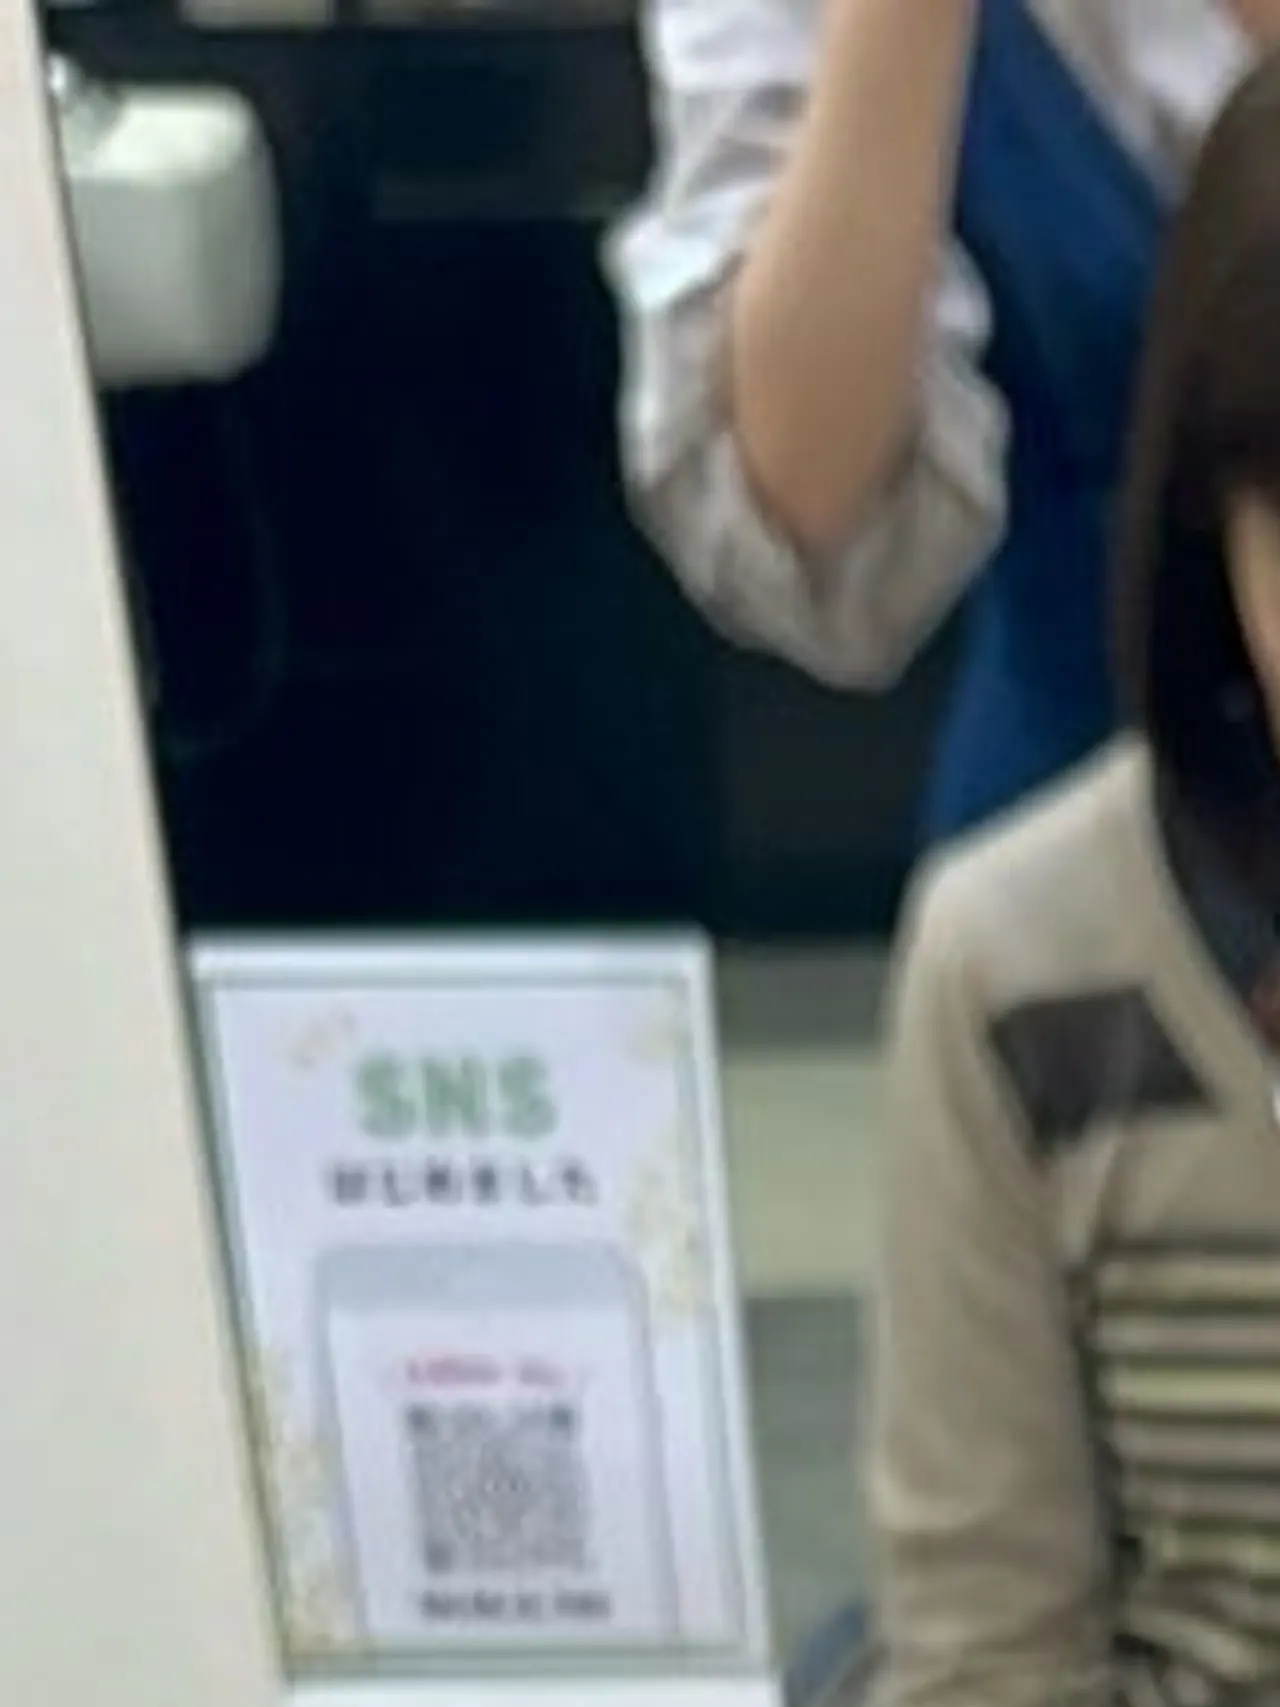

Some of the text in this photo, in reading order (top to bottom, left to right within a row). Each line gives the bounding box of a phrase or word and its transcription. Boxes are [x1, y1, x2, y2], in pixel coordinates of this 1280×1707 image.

[353, 1050, 560, 1142] SNS
[324, 1156, 602, 1209] はじめました
